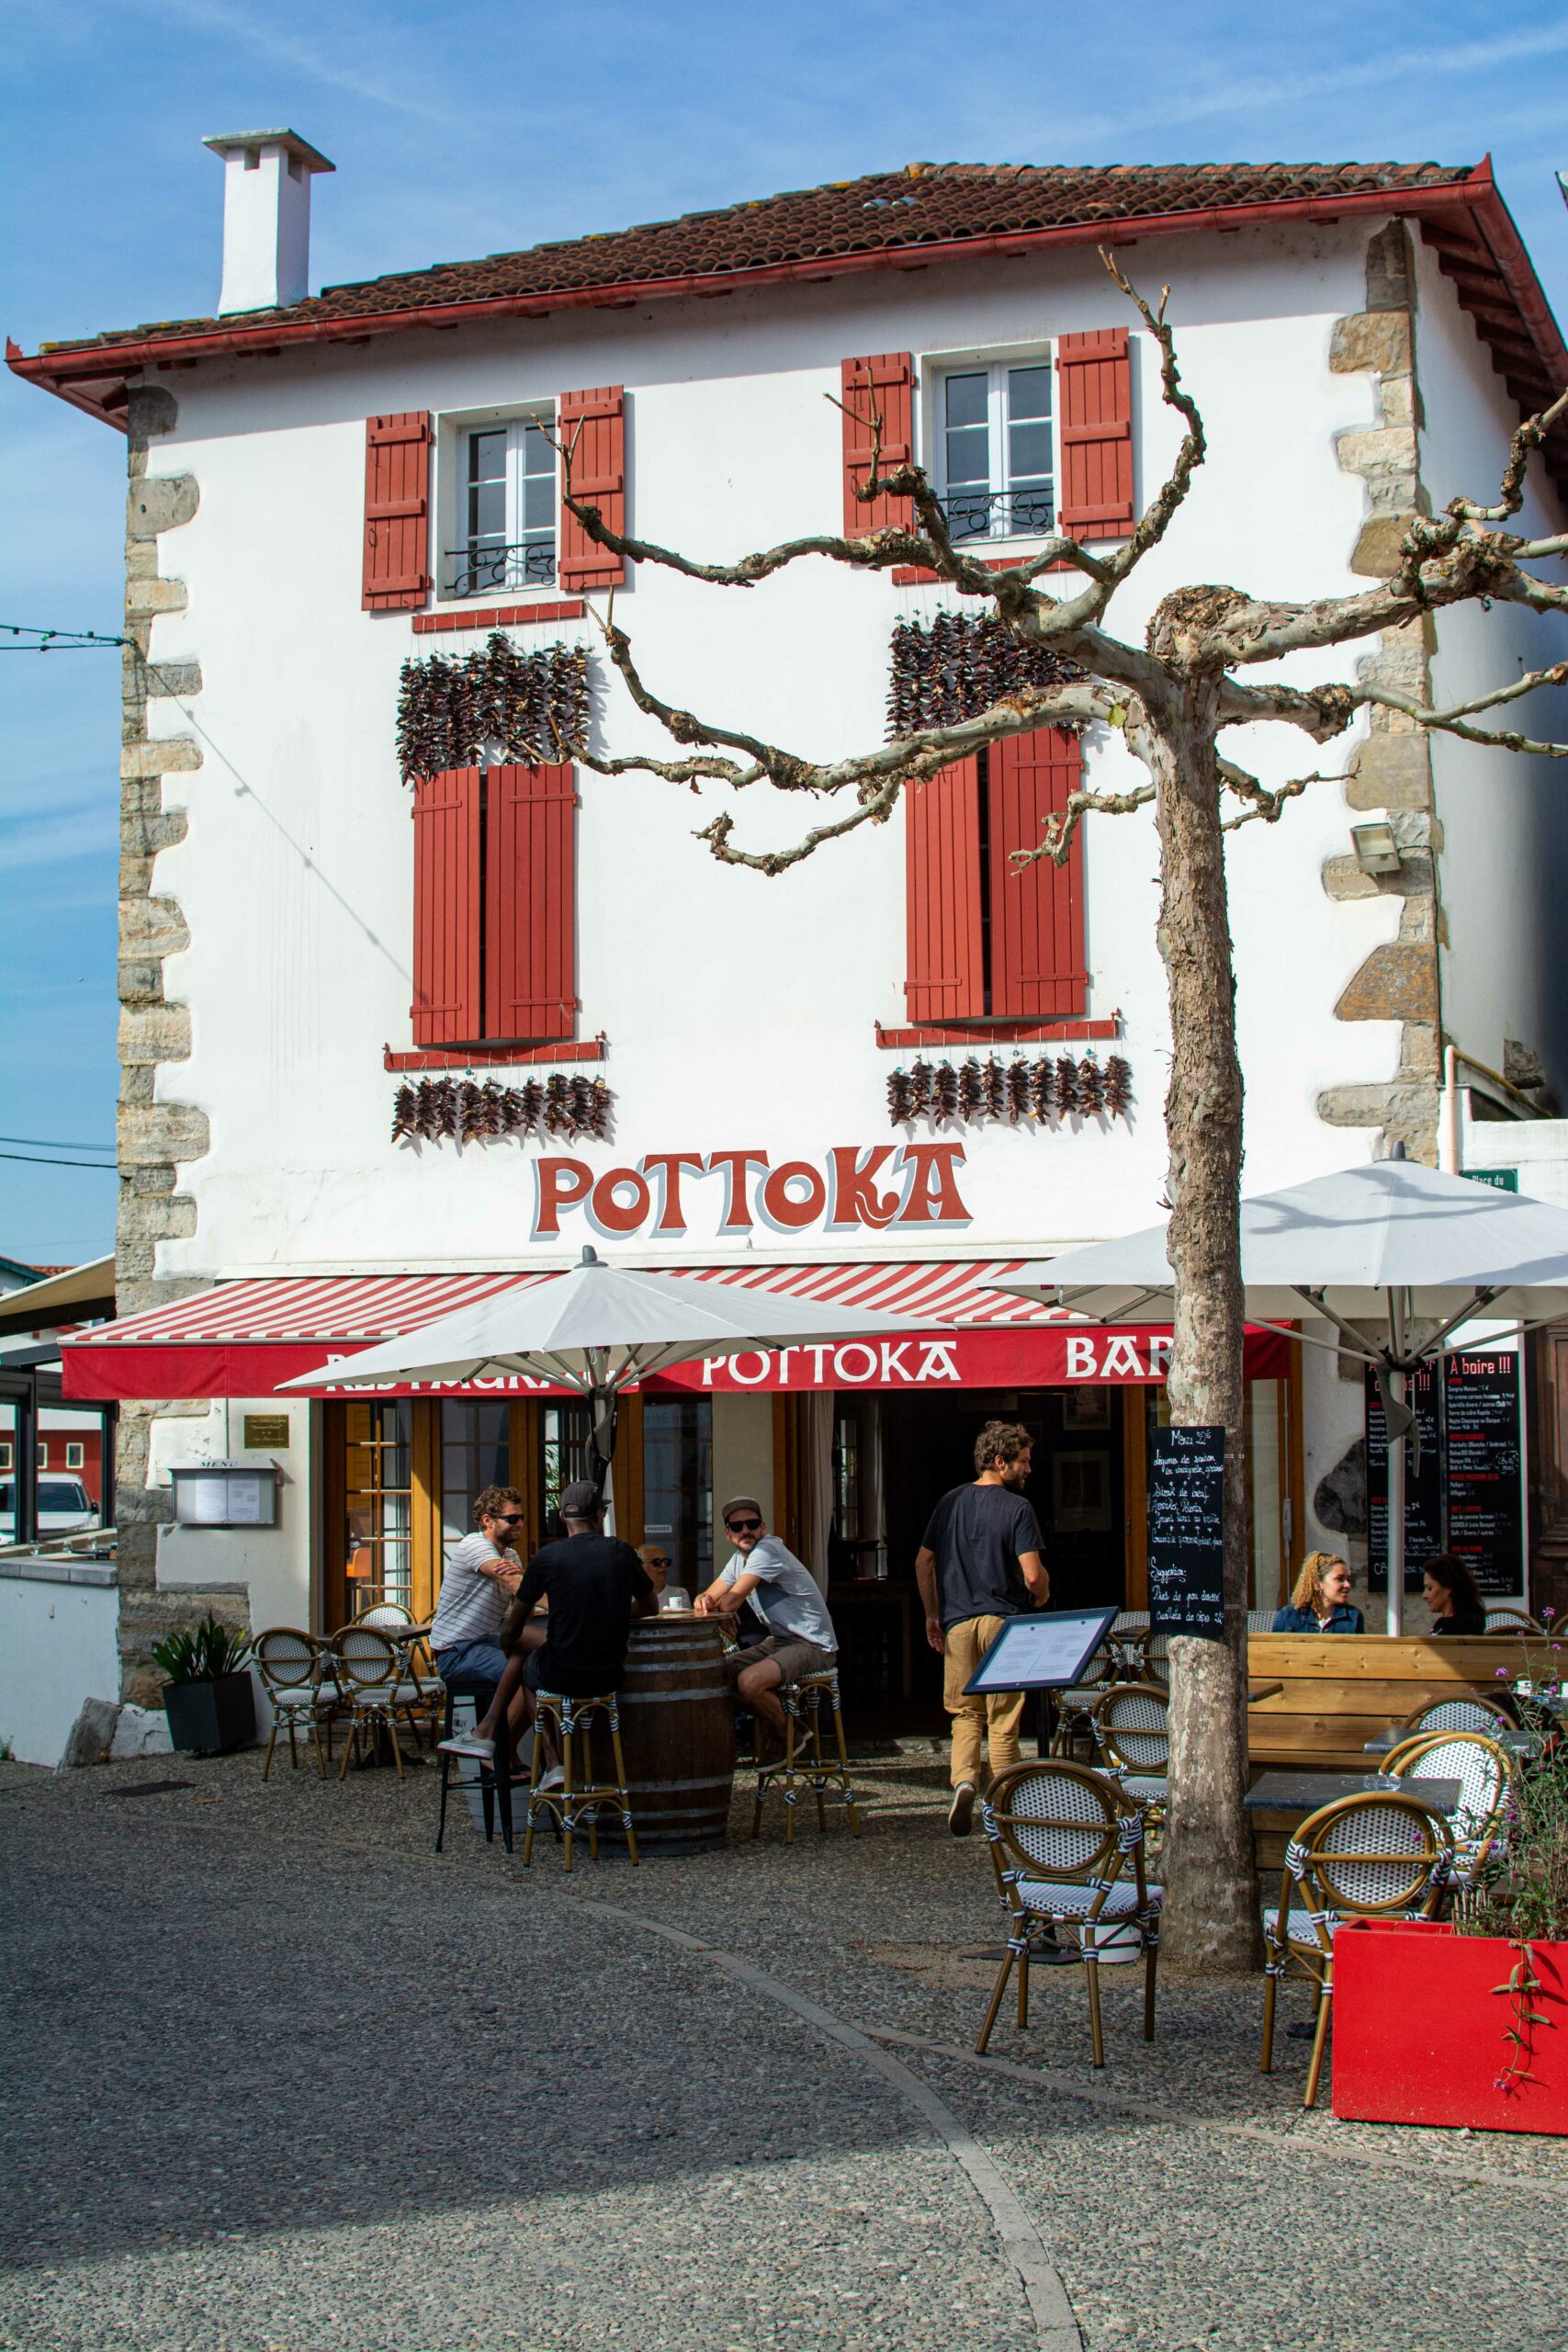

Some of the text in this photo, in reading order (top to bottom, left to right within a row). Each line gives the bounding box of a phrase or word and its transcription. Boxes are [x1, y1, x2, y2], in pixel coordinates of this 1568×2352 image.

[1495, 1174, 1505, 1185] du
[530, 1142, 974, 1241] POTTOKA
[701, 1340, 962, 1385] POTTOKA
[1066, 1335, 1174, 1378] BAR
[1450, 1355, 1459, 1374] À
[1461, 1357, 1495, 1374] boire
[1498, 1356, 1511, 1374] !!!
[1171, 1430, 1193, 1446] Menu
[1180, 1454, 1190, 1464] de
[1179, 1487, 1189, 1498] de
[1172, 1590, 1182, 1601] de
[1185, 1611, 1195, 1622] de
